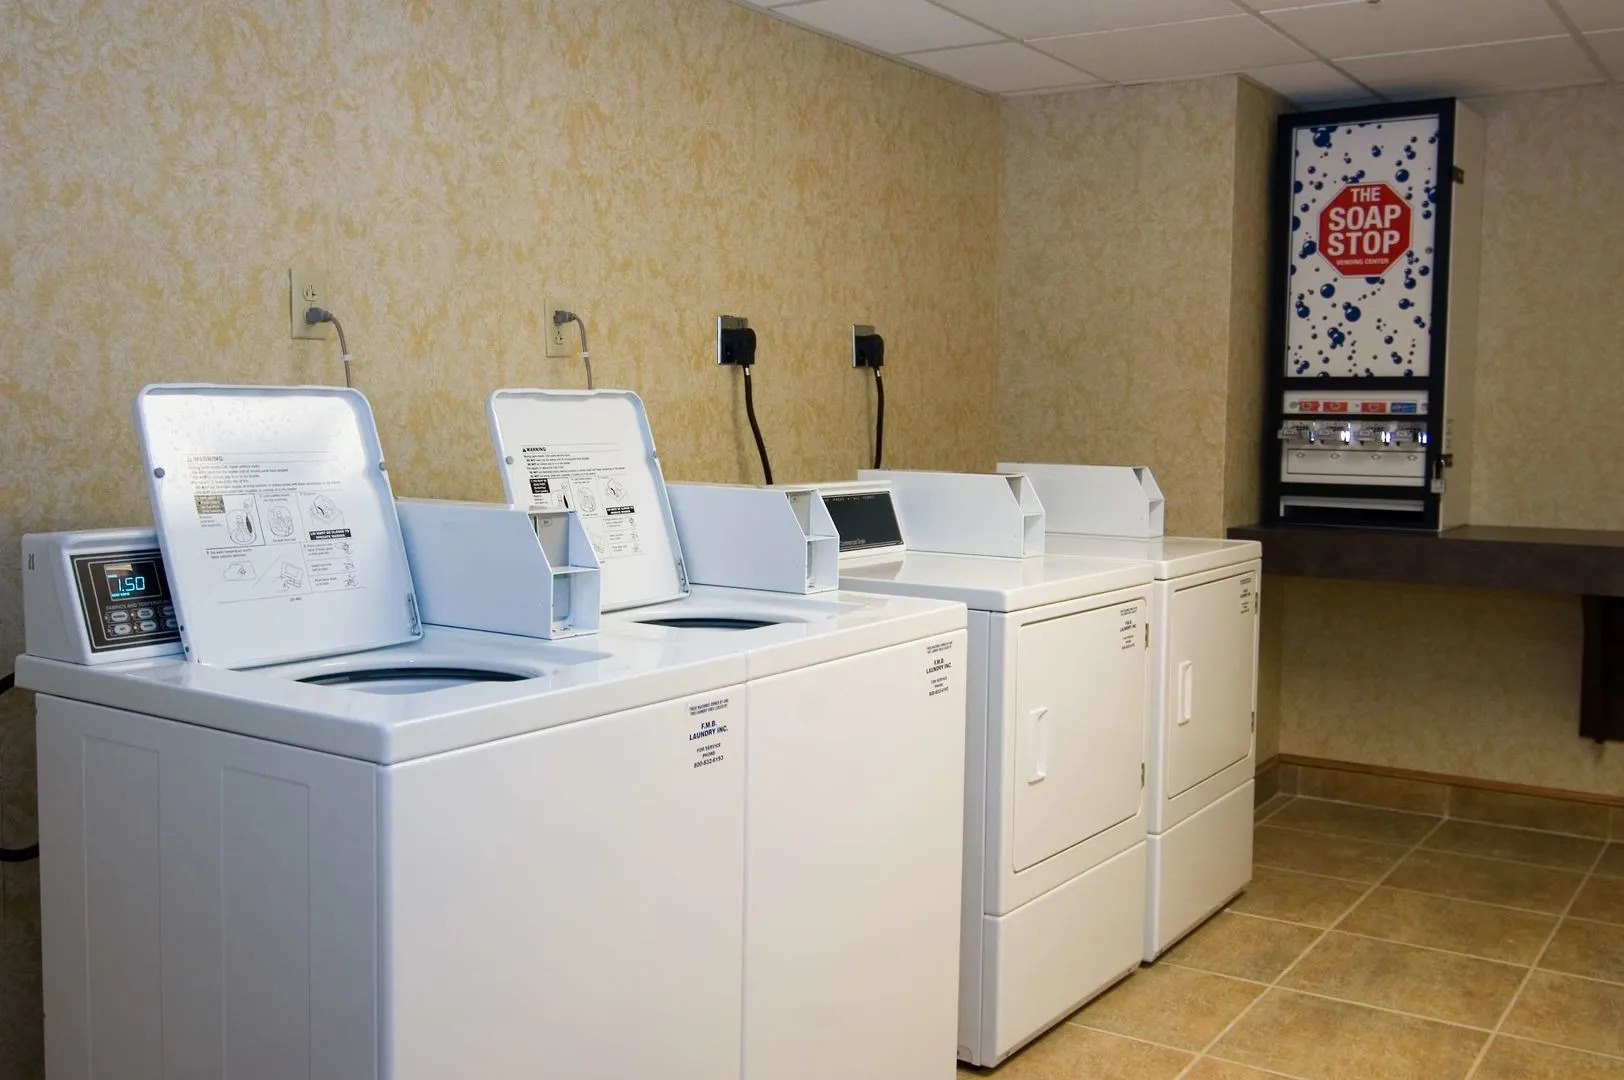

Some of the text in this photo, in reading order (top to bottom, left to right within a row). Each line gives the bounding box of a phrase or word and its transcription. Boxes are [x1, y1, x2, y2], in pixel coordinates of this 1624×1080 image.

[1350, 186, 1381, 203] THE
[1328, 204, 1402, 231] SOAP
[1327, 230, 1401, 256] STOP
[1336, 257, 1389, 266] VENDING CENTER
[117, 576, 145, 592] 1.50
[689, 724, 728, 741] LAUNDRY INC.
[701, 719, 717, 730] F.M.B.
[705, 742, 721, 751] SERVICE
